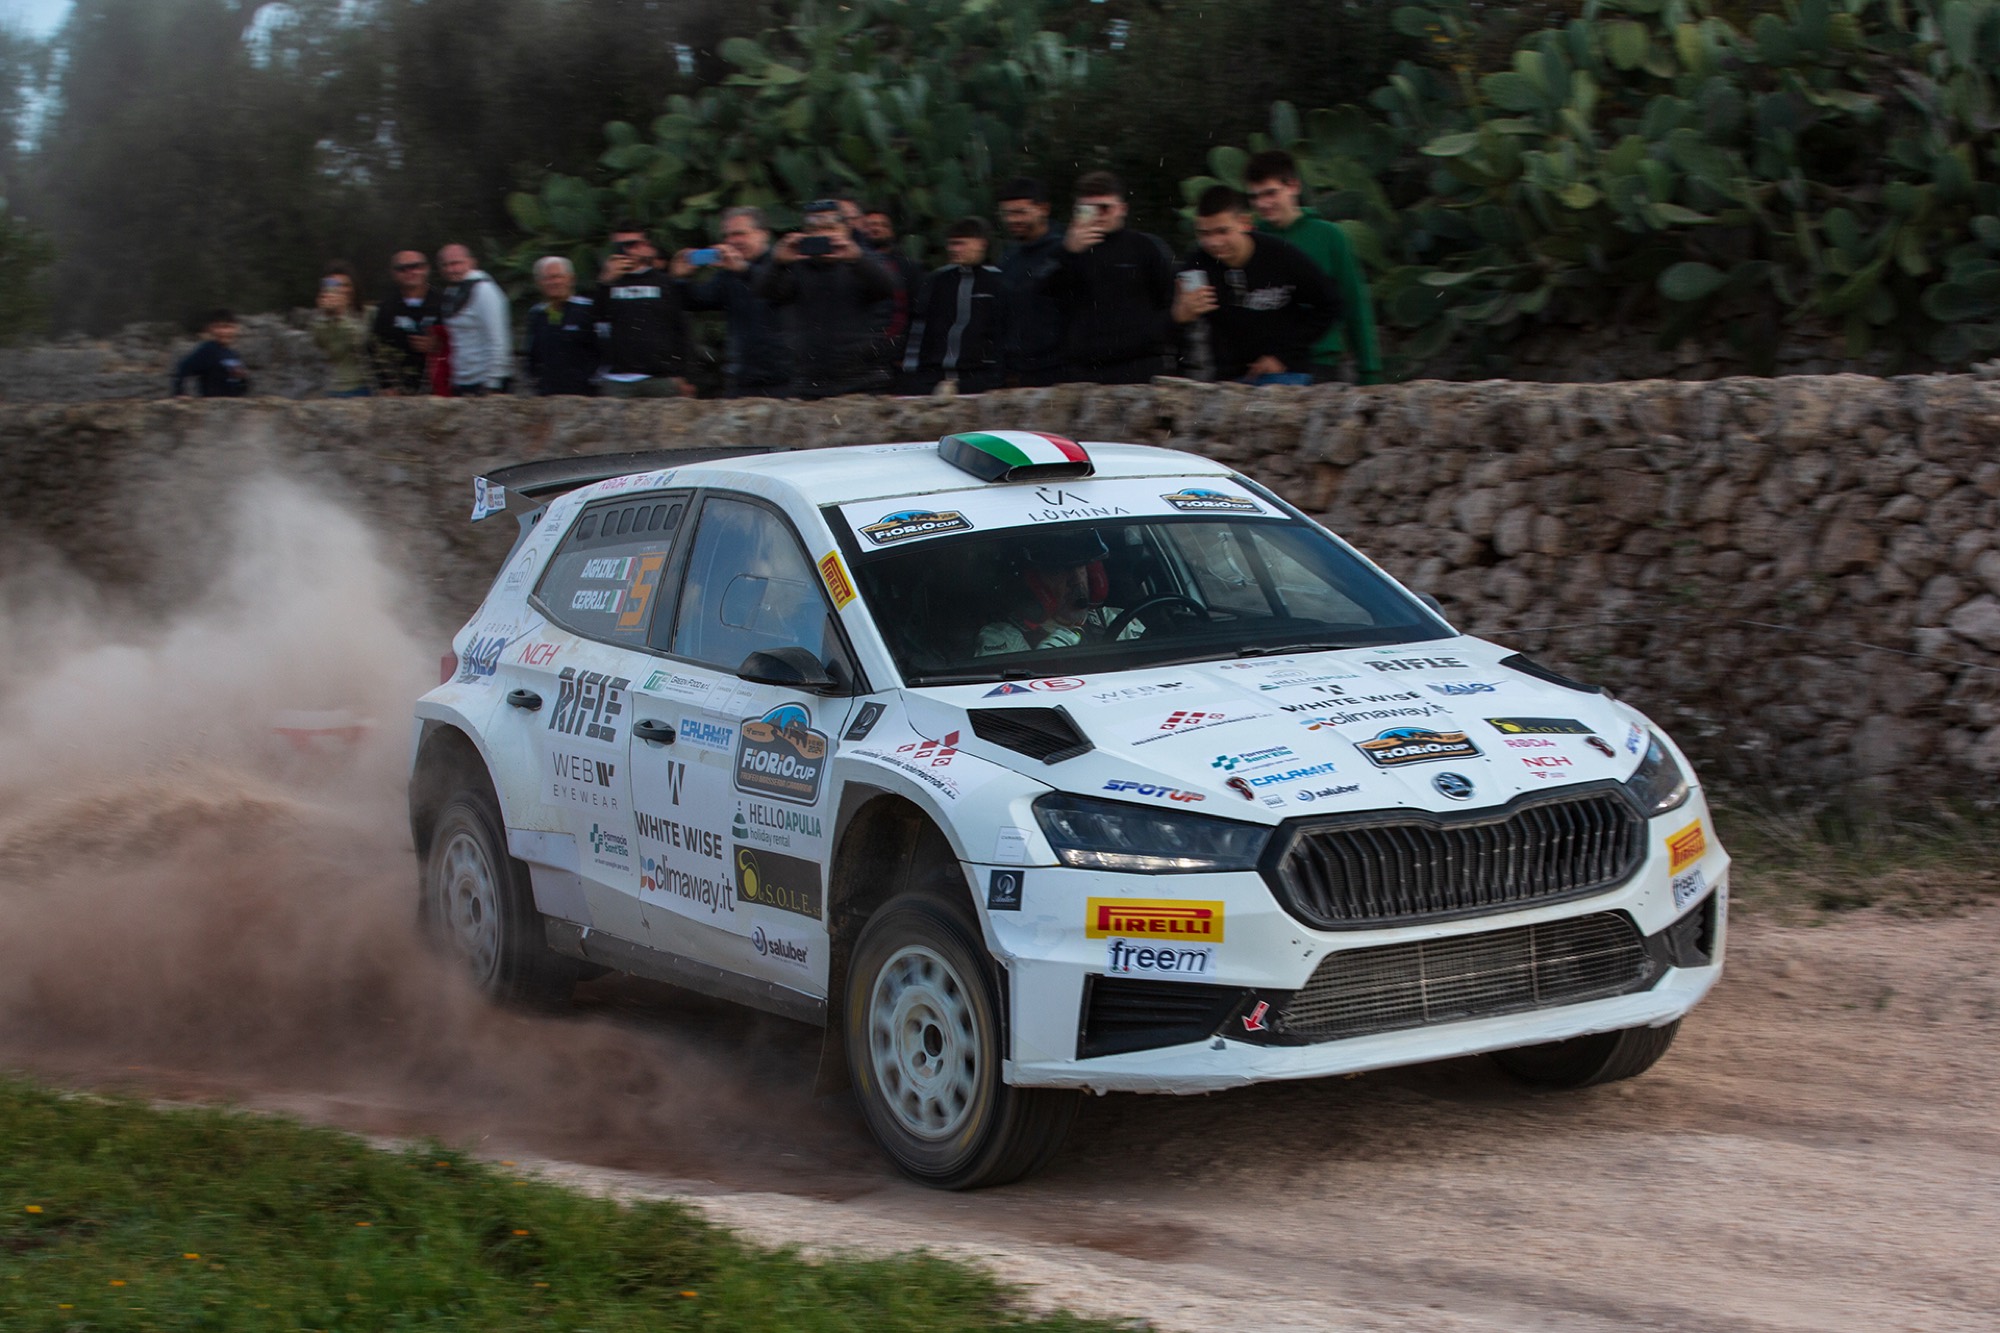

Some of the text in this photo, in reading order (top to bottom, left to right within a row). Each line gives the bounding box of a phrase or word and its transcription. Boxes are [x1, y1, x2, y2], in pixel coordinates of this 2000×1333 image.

[1028, 506, 1130, 522] LUMINA
[618, 557, 664, 626] 5
[821, 556, 851, 604] PIRELLI
[517, 643, 561, 666] NCH
[1364, 657, 1469, 672] RIFLE
[1280, 691, 1422, 712] WHITE WISE
[1330, 702, 1453, 725] climaway.it
[681, 719, 733, 746] CALAMIT
[553, 752, 594, 783] WEB
[793, 764, 816, 780] CUP
[1250, 763, 1335, 787] CALAMIT
[1521, 757, 1573, 768] NCH
[553, 784, 618, 810] EYEWEAR
[1102, 779, 1206, 802] SPOTUP
[750, 803, 822, 838] HELLOAPULIA
[635, 811, 722, 860] WHITE WISE
[750, 828, 791, 847] holiday rental
[655, 854, 734, 914] climaway.it
[1097, 905, 1213, 934] PIRELLI
[769, 938, 807, 963] saluber
[1110, 940, 1206, 972] freem
